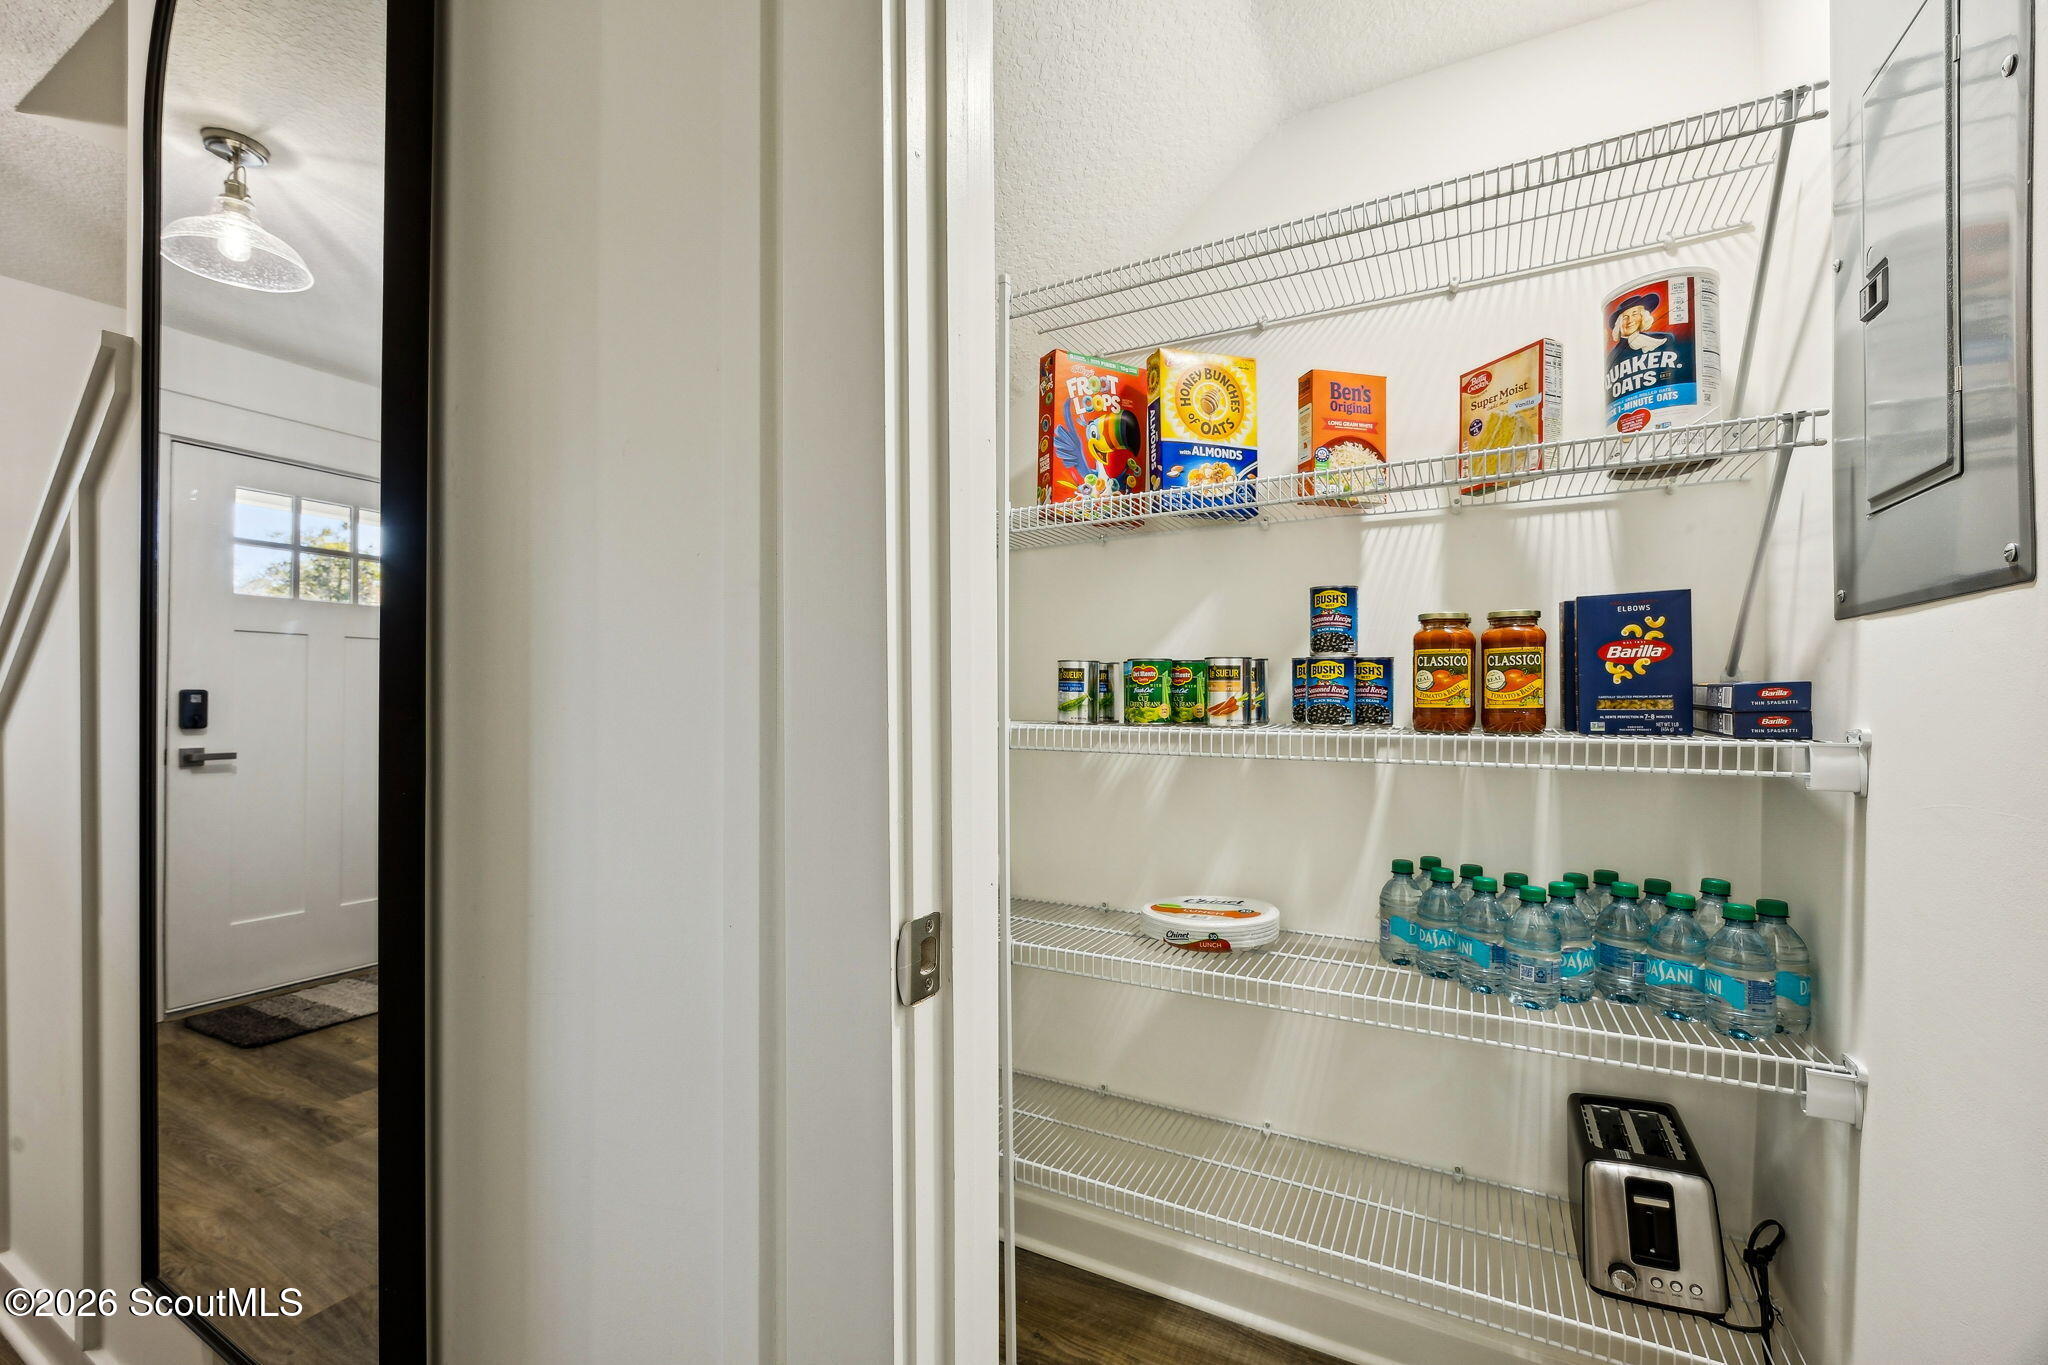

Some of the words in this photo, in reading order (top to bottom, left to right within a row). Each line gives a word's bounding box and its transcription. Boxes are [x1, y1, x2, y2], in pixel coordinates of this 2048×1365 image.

[1066, 375, 1119, 398] FROOT
[1180, 369, 1202, 407] HONEY
[1204, 367, 1241, 414] BUNCHES
[1329, 381, 1372, 402] Ben's
[1612, 371, 1657, 398] OATS
[1470, 394, 1499, 411] Super
[1499, 381, 1529, 400] Moist
[1617, 395, 1654, 414] 1-MINUTE
[1657, 391, 1678, 402] OATS
[1073, 394, 1121, 415] LOOPS
[1329, 400, 1372, 415] Original
[1188, 413, 1201, 424] of
[1200, 418, 1235, 436] OATS
[1149, 409, 1158, 471] ALMONDS
[1191, 445, 1243, 461] ALMONDS
[1316, 594, 1346, 606] BUSH'S
[1617, 604, 1651, 613] ELBOWS
[1606, 645, 1663, 658] Barilla
[1418, 656, 1468, 666] CLASSICO
[1488, 654, 1541, 666] CLASSICO
[1215, 669, 1239, 678] SUEUR
[1312, 665, 1343, 676] BUSH'S
[1356, 666, 1382, 676] USH'S
[1331, 686, 1349, 695] Recipe
[1761, 688, 1788, 697] Barilla
[1166, 930, 1189, 939] Chinet
[1419, 929, 1456, 948] DASAN
[1647, 958, 1693, 984] DASANI
